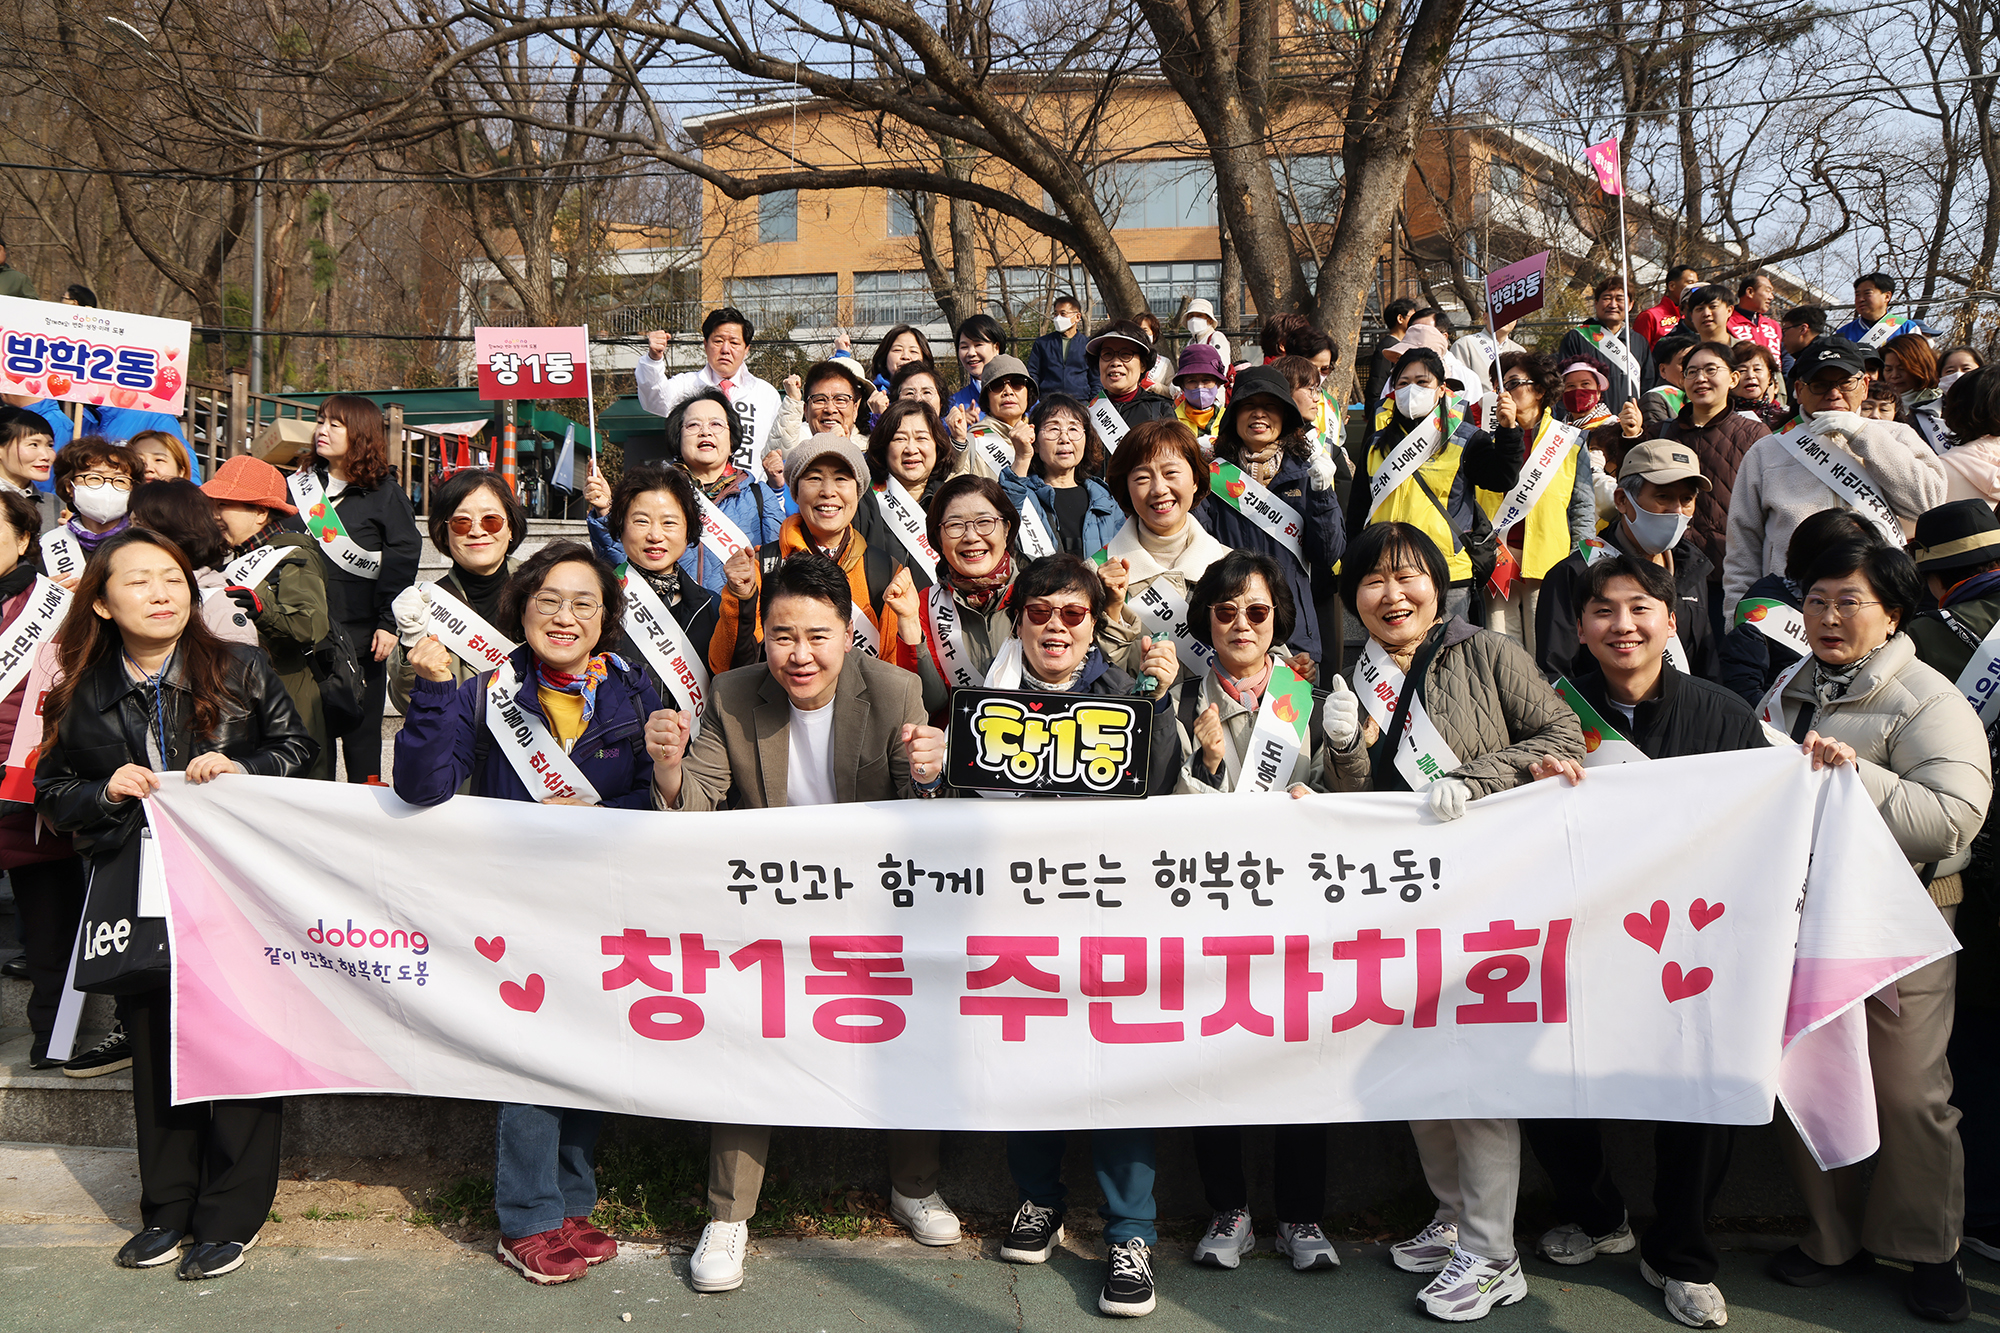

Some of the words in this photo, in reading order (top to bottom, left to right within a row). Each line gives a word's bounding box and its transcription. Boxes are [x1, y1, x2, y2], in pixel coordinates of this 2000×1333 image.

[1490, 270, 1541, 314] 방학3동
[72, 313, 111, 326] dobong
[6, 334, 156, 389] 방학2동
[489, 351, 575, 386] 창1동
[1391, 437, 1428, 472] 도봉구
[1795, 435, 1830, 466] 도봉구
[1515, 468, 1542, 504] 복구는
[1244, 491, 1284, 525] 산불은
[1140, 586, 1174, 621] 배낭
[937, 605, 958, 661] 도봉구
[669, 655, 705, 717] 흡연NO
[491, 686, 535, 749] 산불은
[529, 750, 577, 799] 한순간
[972, 700, 1134, 787] 창1동
[727, 859, 855, 906] 주민과
[877, 854, 985, 908] 함께
[1010, 857, 1127, 908] 만드는
[1152, 850, 1285, 911] 행복한
[1308, 849, 1442, 904] 창1동!
[84, 917, 132, 961] Lee
[307, 918, 429, 955] dobong
[263, 946, 297, 967] 같이
[395, 961, 430, 986] 도봉
[601, 927, 913, 1044] 창1동
[959, 917, 1573, 1044] 주민자치회
